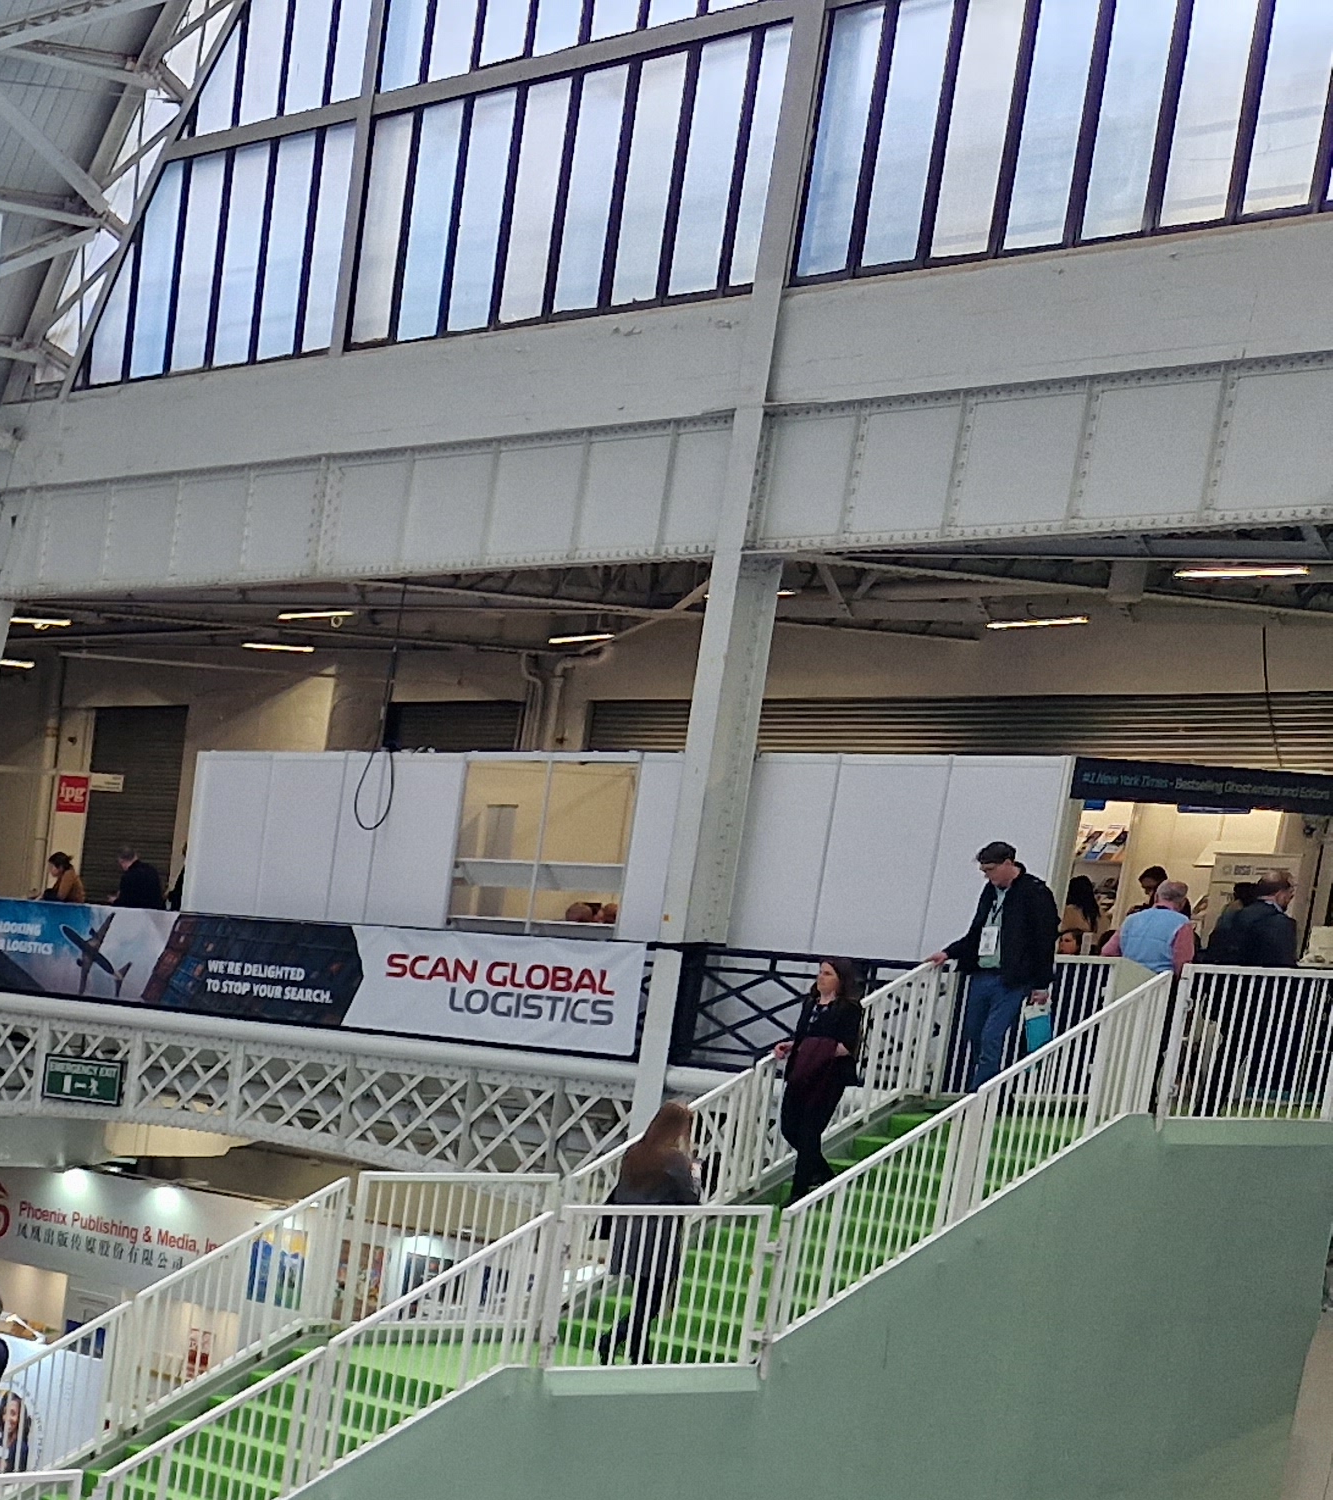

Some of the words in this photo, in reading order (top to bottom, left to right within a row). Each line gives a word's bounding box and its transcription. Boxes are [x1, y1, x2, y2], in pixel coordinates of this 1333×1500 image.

[59, 782, 86, 803] ipg
[1097, 774, 1119, 785] New
[1140, 776, 1169, 789] Times
[1175, 778, 1224, 795] Bestselling
[5, 937, 53, 956] LOGISTICS
[206, 958, 241, 977] WE'RE
[243, 961, 306, 982] DELIGHTED
[385, 953, 477, 985] SCAN
[484, 958, 615, 997] GLOBAL
[205, 978, 221, 994] TO
[221, 979, 251, 997] STOP
[251, 982, 282, 1000] YOUR
[283, 985, 333, 1006] SEARCH.
[448, 987, 614, 1026] LOGISTICS
[49, 1060, 98, 1077] EMERGENCY
[99, 1064, 118, 1078] EXIT
[19, 1200, 68, 1226] Phoenix
[71, 1212, 139, 1245] Publishing
[142, 1228, 153, 1243] &
[157, 1228, 201, 1255] Media,
